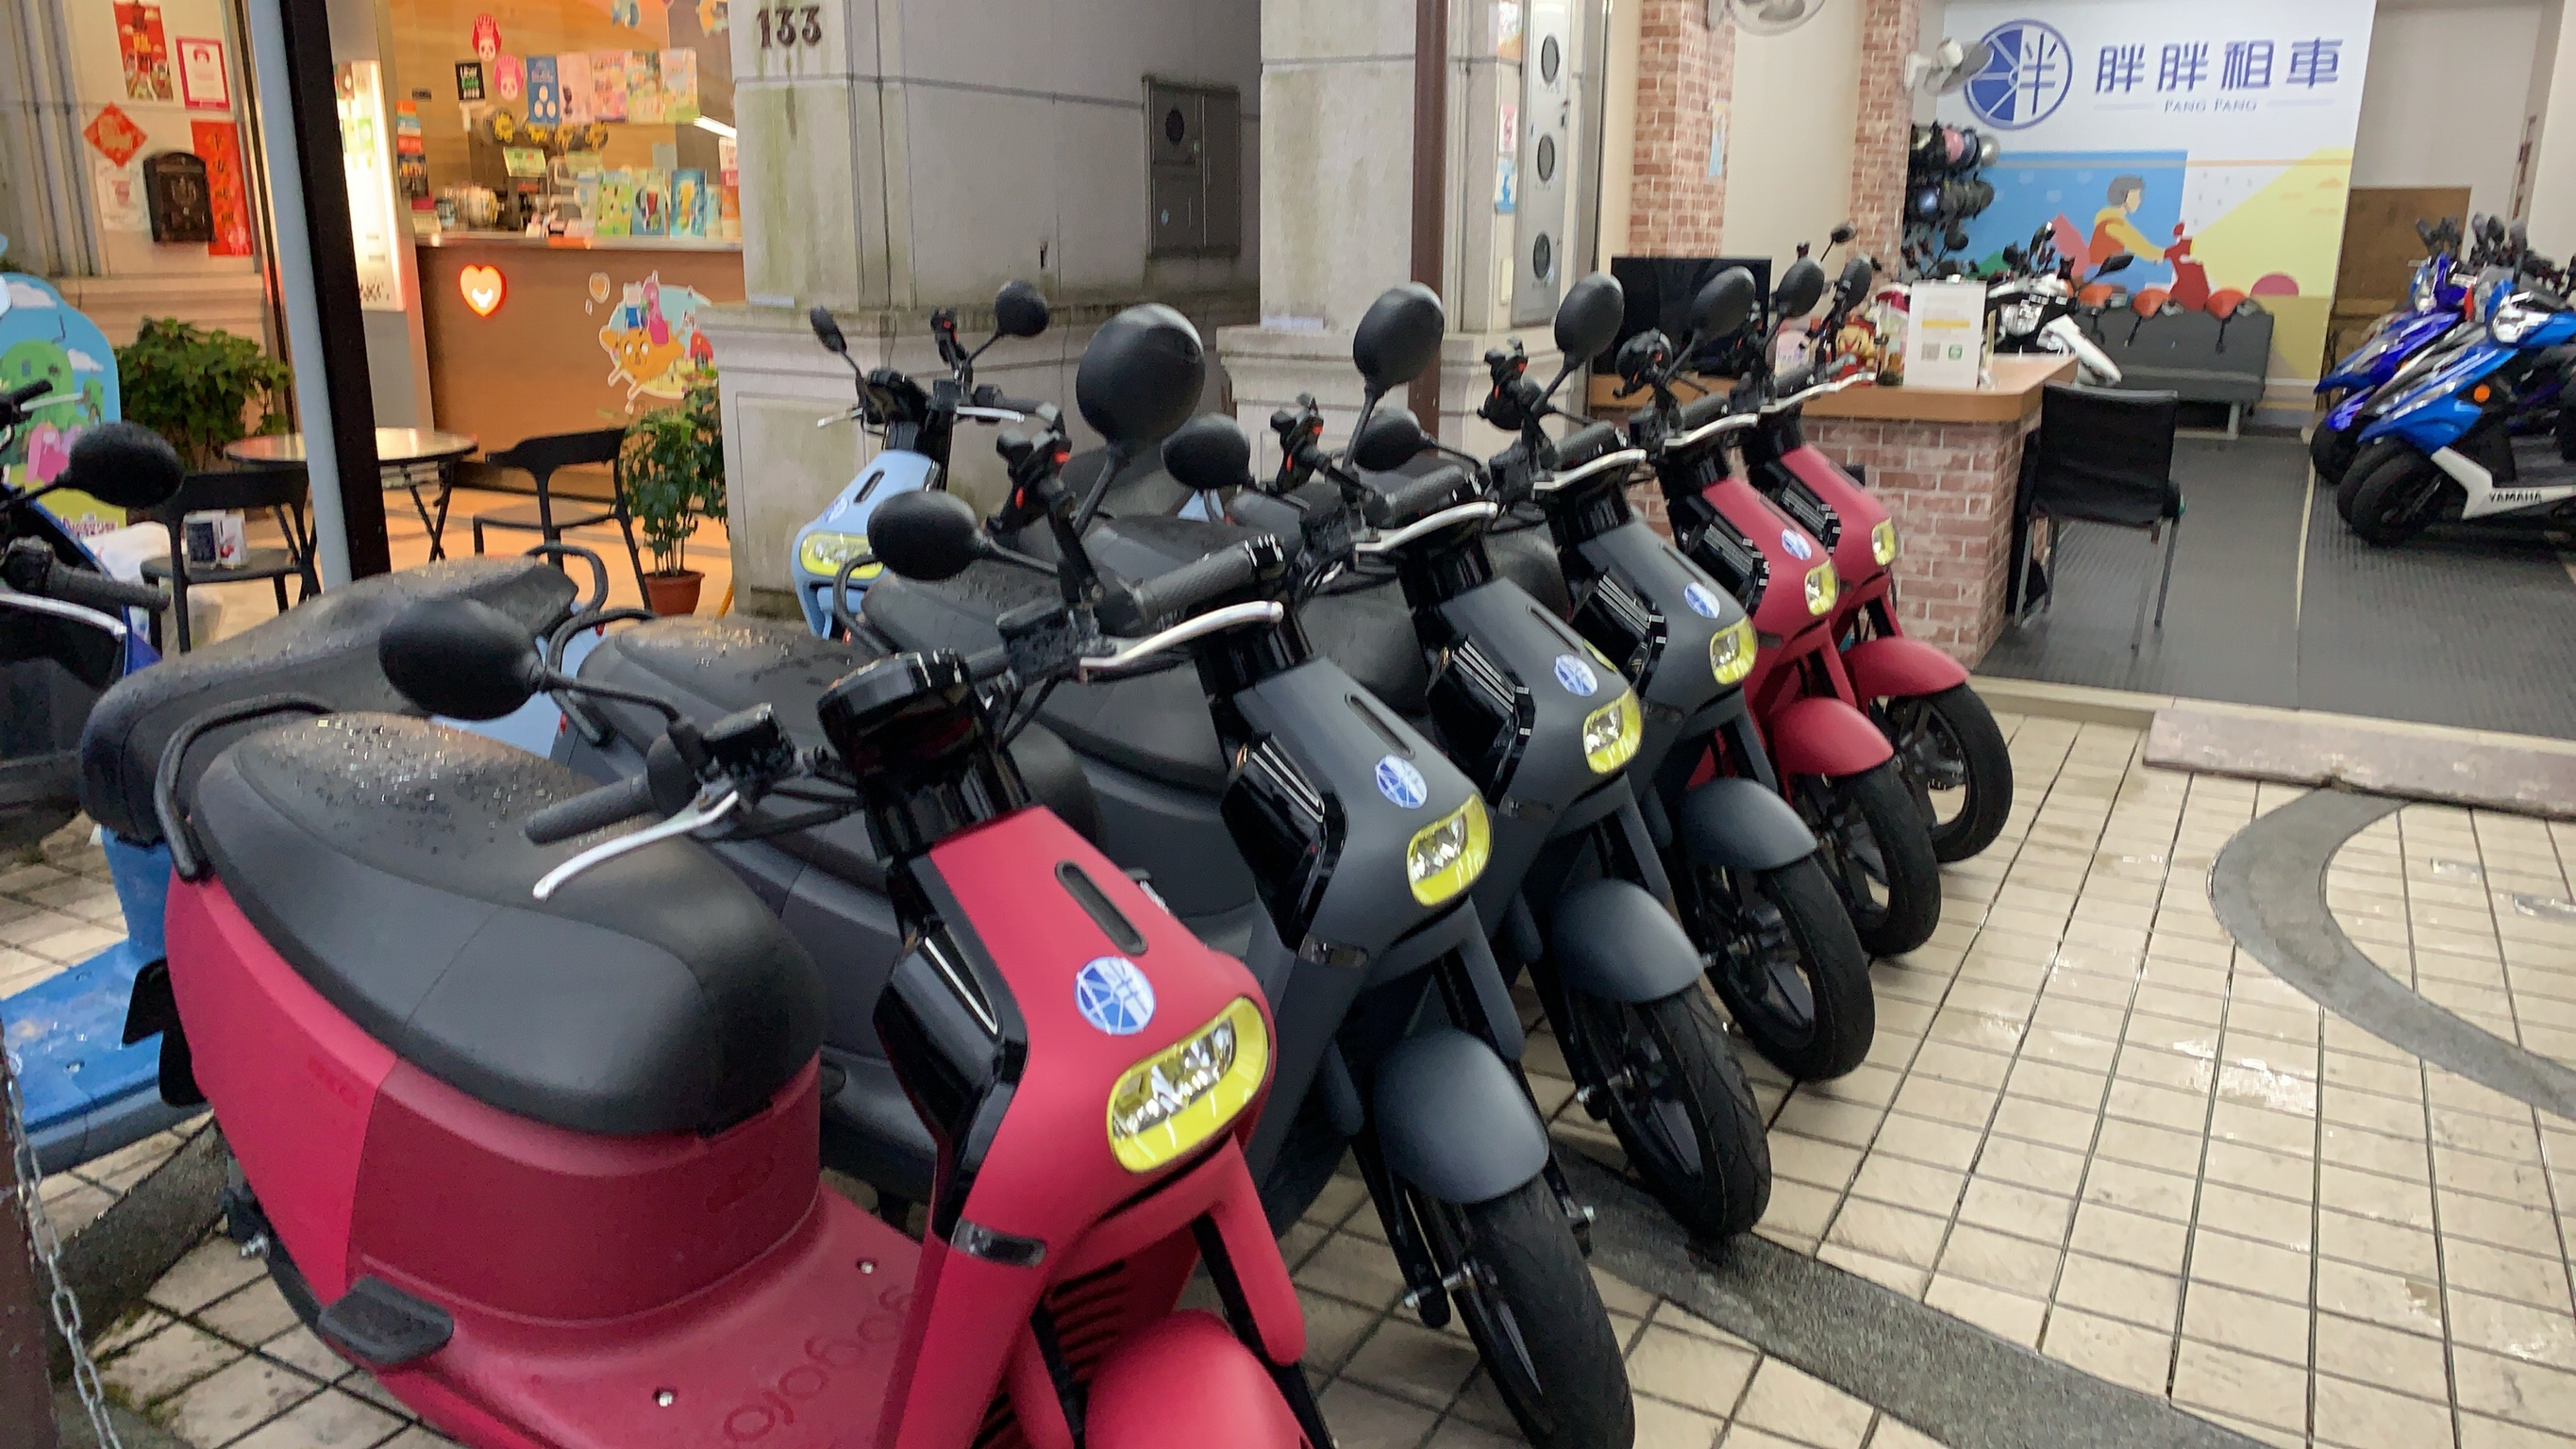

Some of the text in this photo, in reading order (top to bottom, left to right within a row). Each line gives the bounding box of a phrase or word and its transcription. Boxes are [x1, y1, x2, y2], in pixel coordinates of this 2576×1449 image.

[757, 6, 822, 48] 133
[2095, 37, 2343, 93] 胖胖租車
[2164, 97, 2257, 113] PANG PANG
[2489, 491, 2542, 503] YAMAHA
